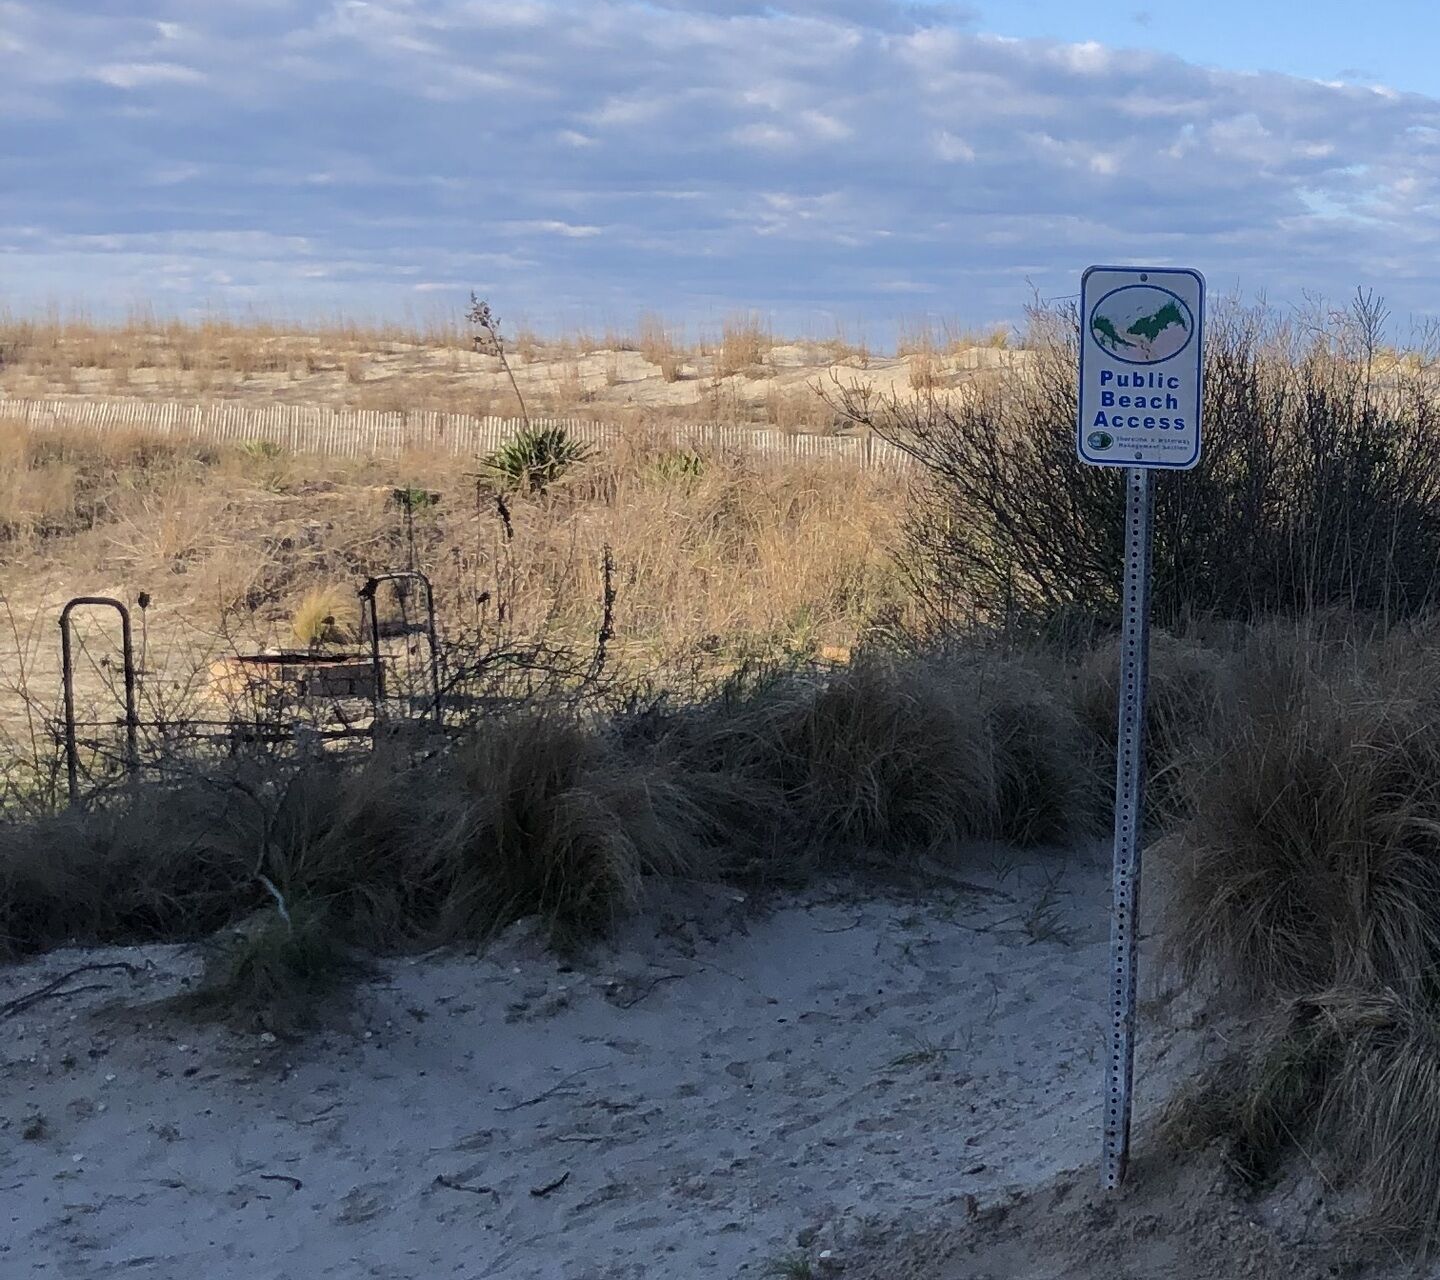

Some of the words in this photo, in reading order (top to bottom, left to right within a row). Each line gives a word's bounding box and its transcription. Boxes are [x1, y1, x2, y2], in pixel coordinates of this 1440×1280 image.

[1100, 370, 1179, 389] Public
[1101, 391, 1178, 409] Beach
[1093, 411, 1185, 430] Access
